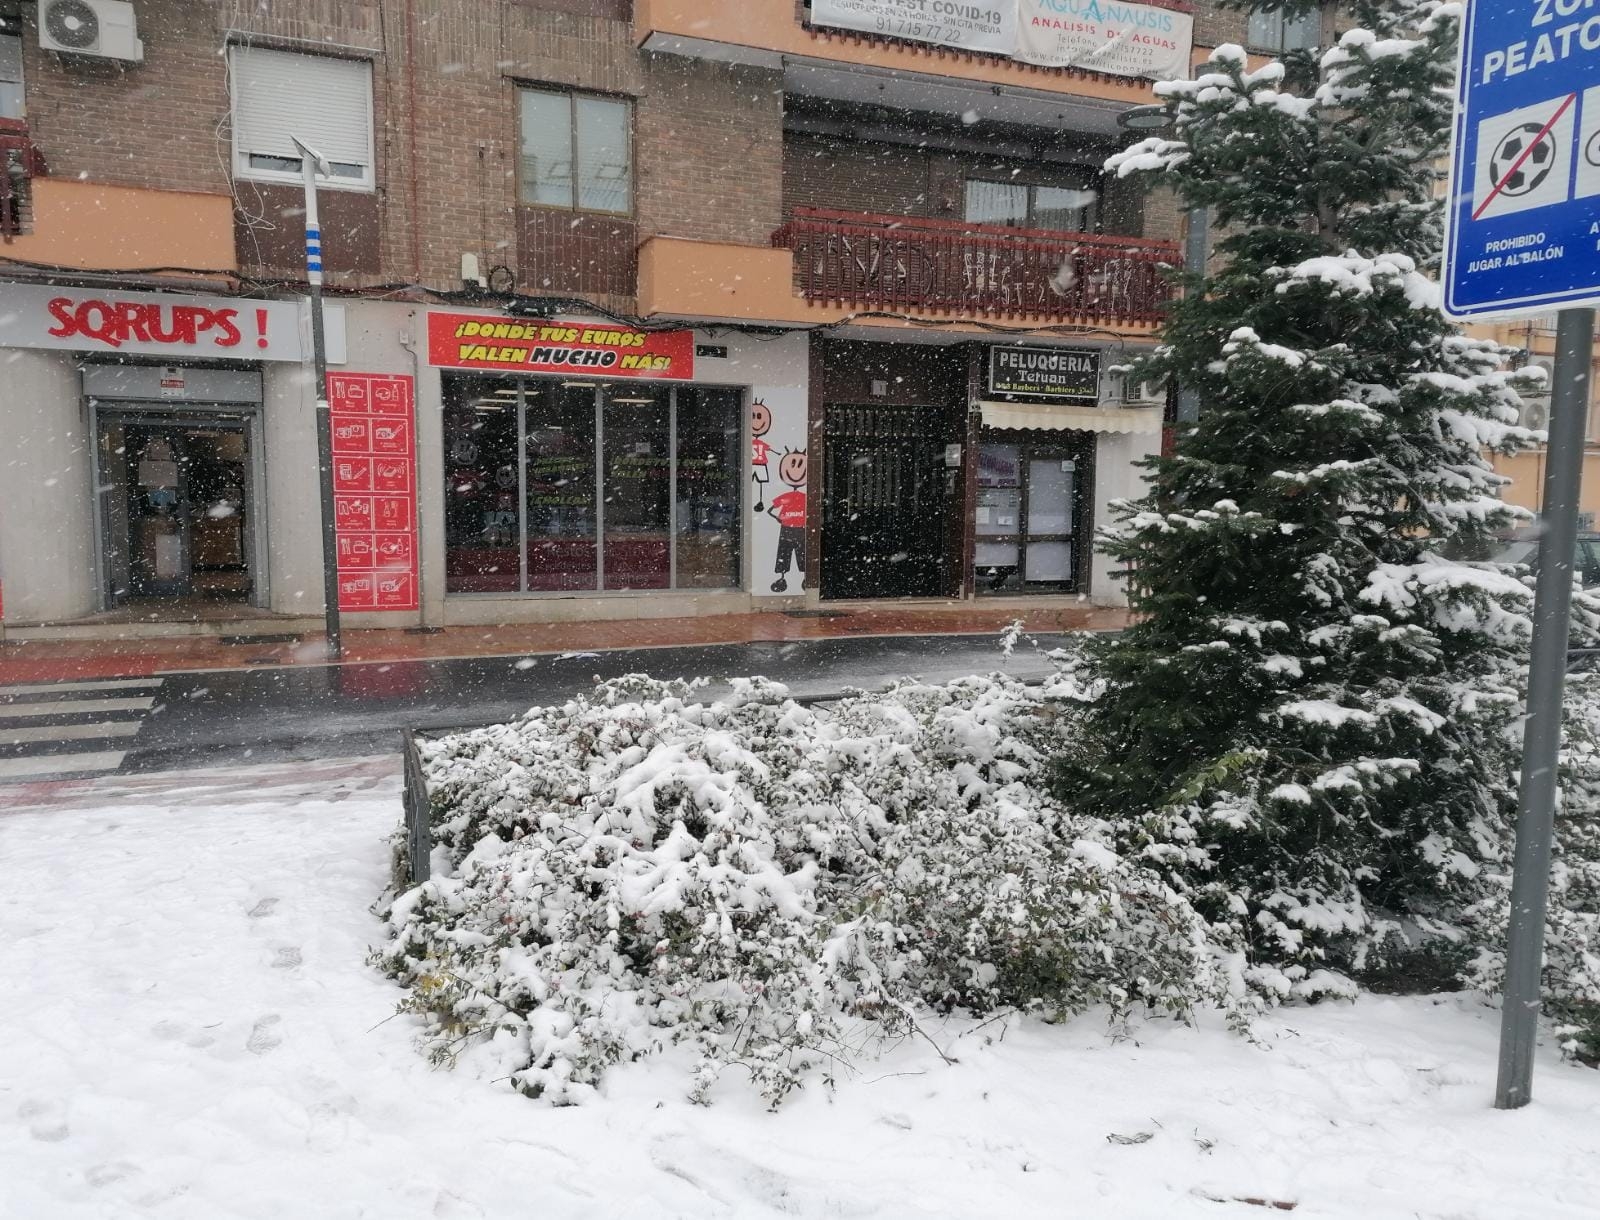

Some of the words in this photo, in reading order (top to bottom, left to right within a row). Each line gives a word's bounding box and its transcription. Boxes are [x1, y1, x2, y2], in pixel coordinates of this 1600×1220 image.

[932, 1, 1002, 25] COVID-19
[944, 16, 956, 27] SIN
[957, 19, 973, 30] CITA
[975, 22, 1001, 34] PREVIA
[876, 16, 892, 32] 91
[897, 20, 921, 36] 715
[927, 24, 942, 40] 77
[945, 28, 960, 42] 22
[1132, 33, 1176, 50] AGUAS
[1485, 232, 1546, 254] PROHIBIDO
[1467, 257, 1502, 273] JUGAR
[1504, 254, 1520, 267] AL
[1521, 244, 1564, 264] BALÓN
[48, 297, 242, 348] SQRUPS
[455, 321, 538, 341] ¡DONDE
[538, 326, 579, 343] TUS
[580, 329, 647, 348] EUROS
[458, 344, 529, 363] VALEN
[529, 346, 618, 368] MUCHO
[618, 353, 672, 372] MÁS!
[1000, 352, 1093, 373] PELUQUERIA
[1018, 369, 1067, 384] Tetuan
